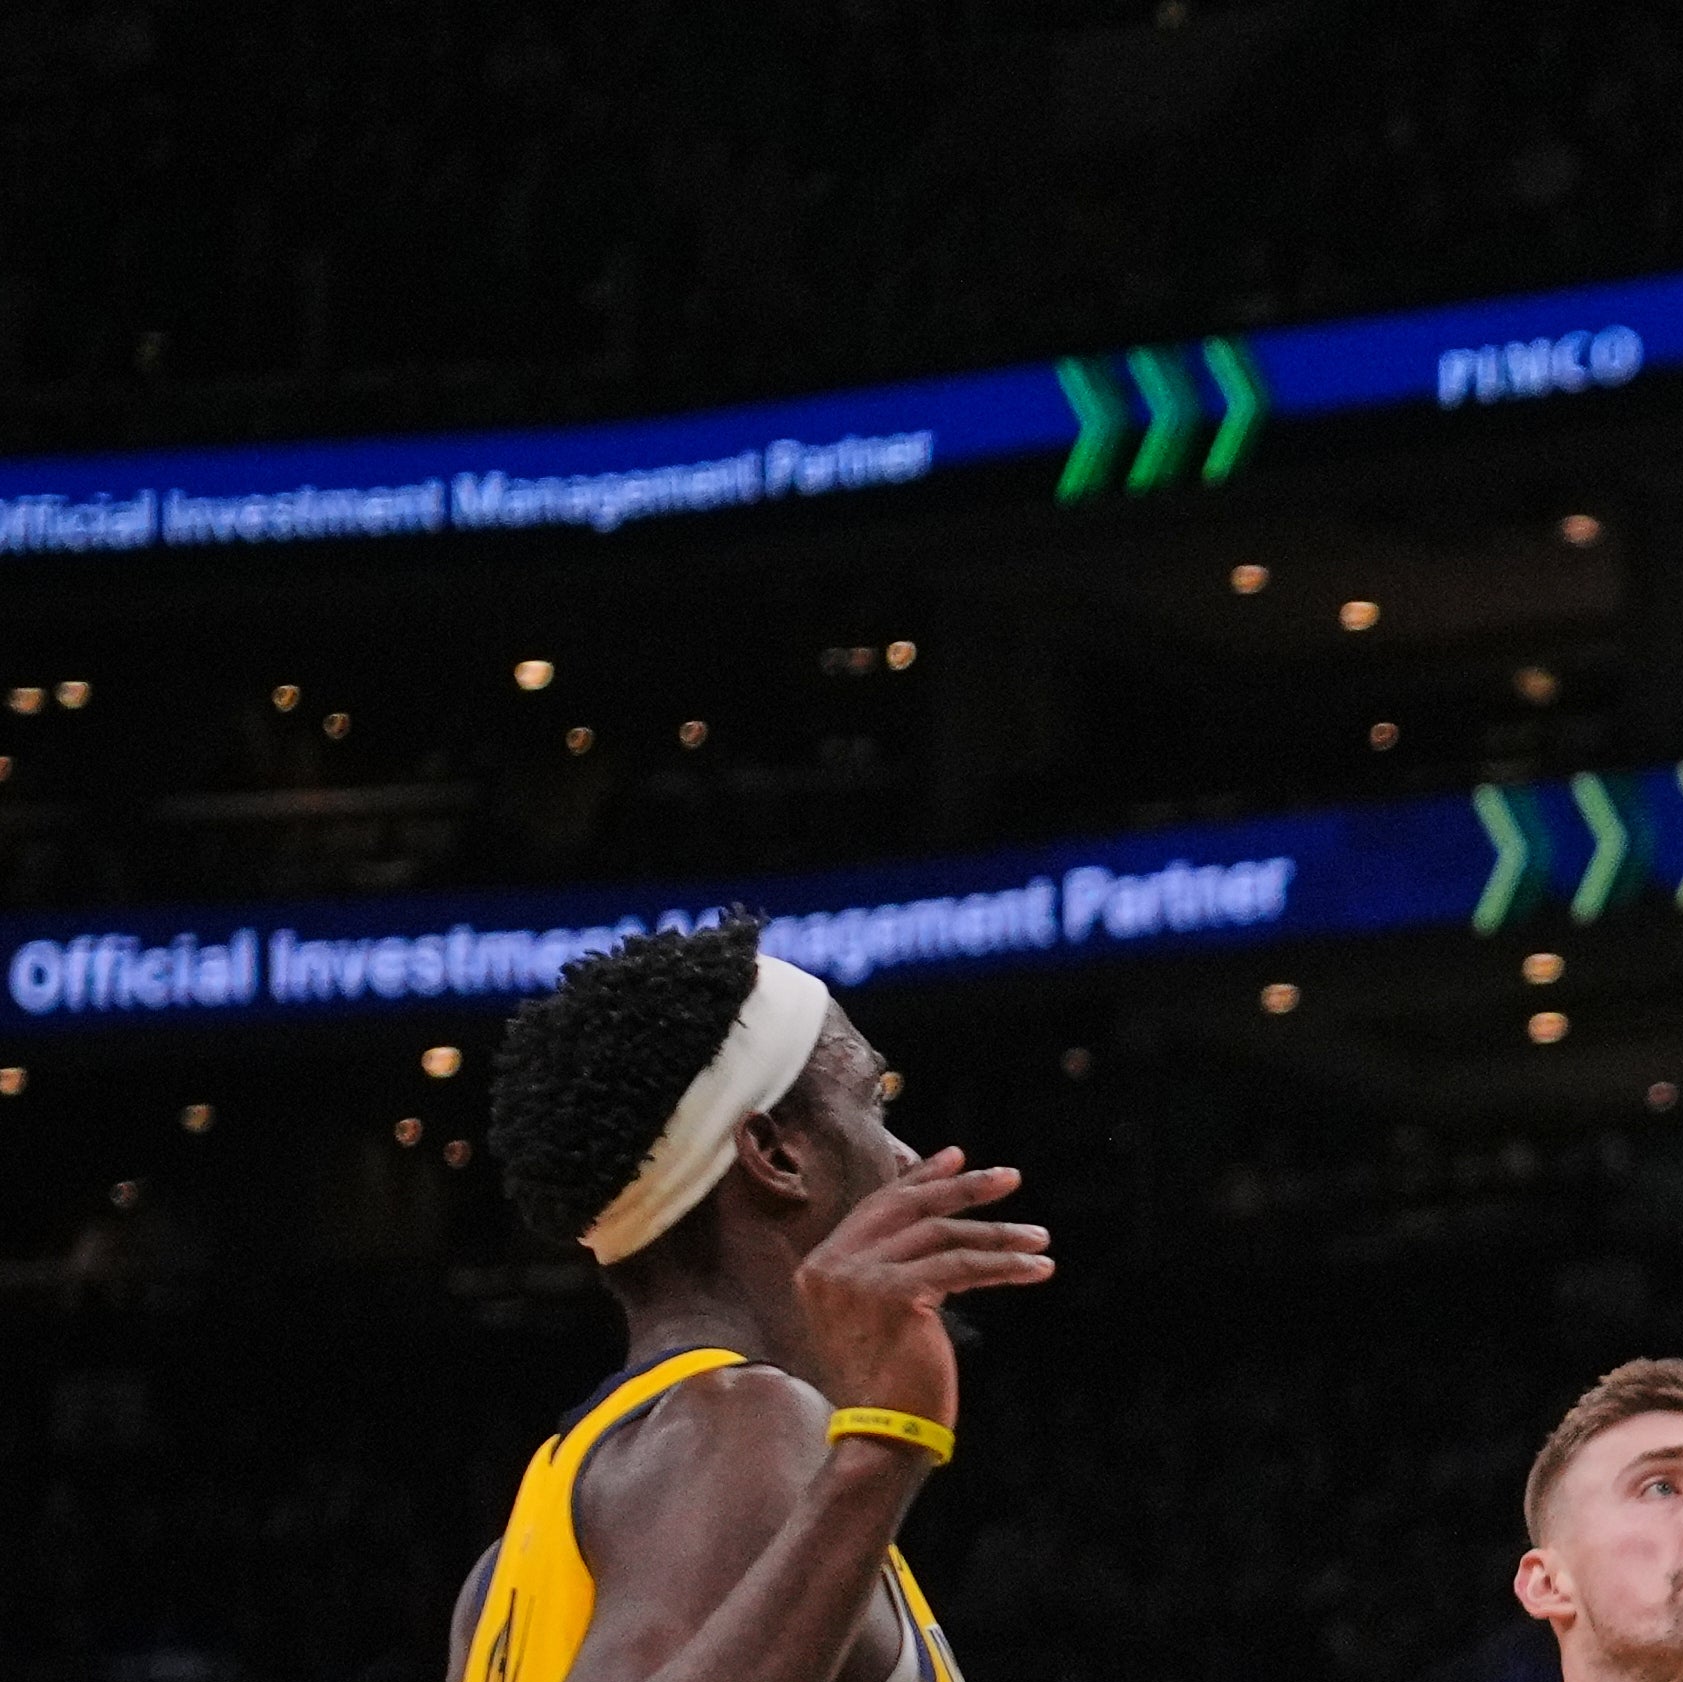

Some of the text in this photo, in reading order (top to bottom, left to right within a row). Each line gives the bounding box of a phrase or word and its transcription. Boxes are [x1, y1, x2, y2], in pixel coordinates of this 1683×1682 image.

[1437, 324, 1644, 410] PIMCO
[162, 476, 446, 546] Investment
[451, 448, 764, 533] Management
[764, 430, 934, 497] Partner
[9, 925, 260, 1013] Official
[1063, 855, 1296, 943] Partner
